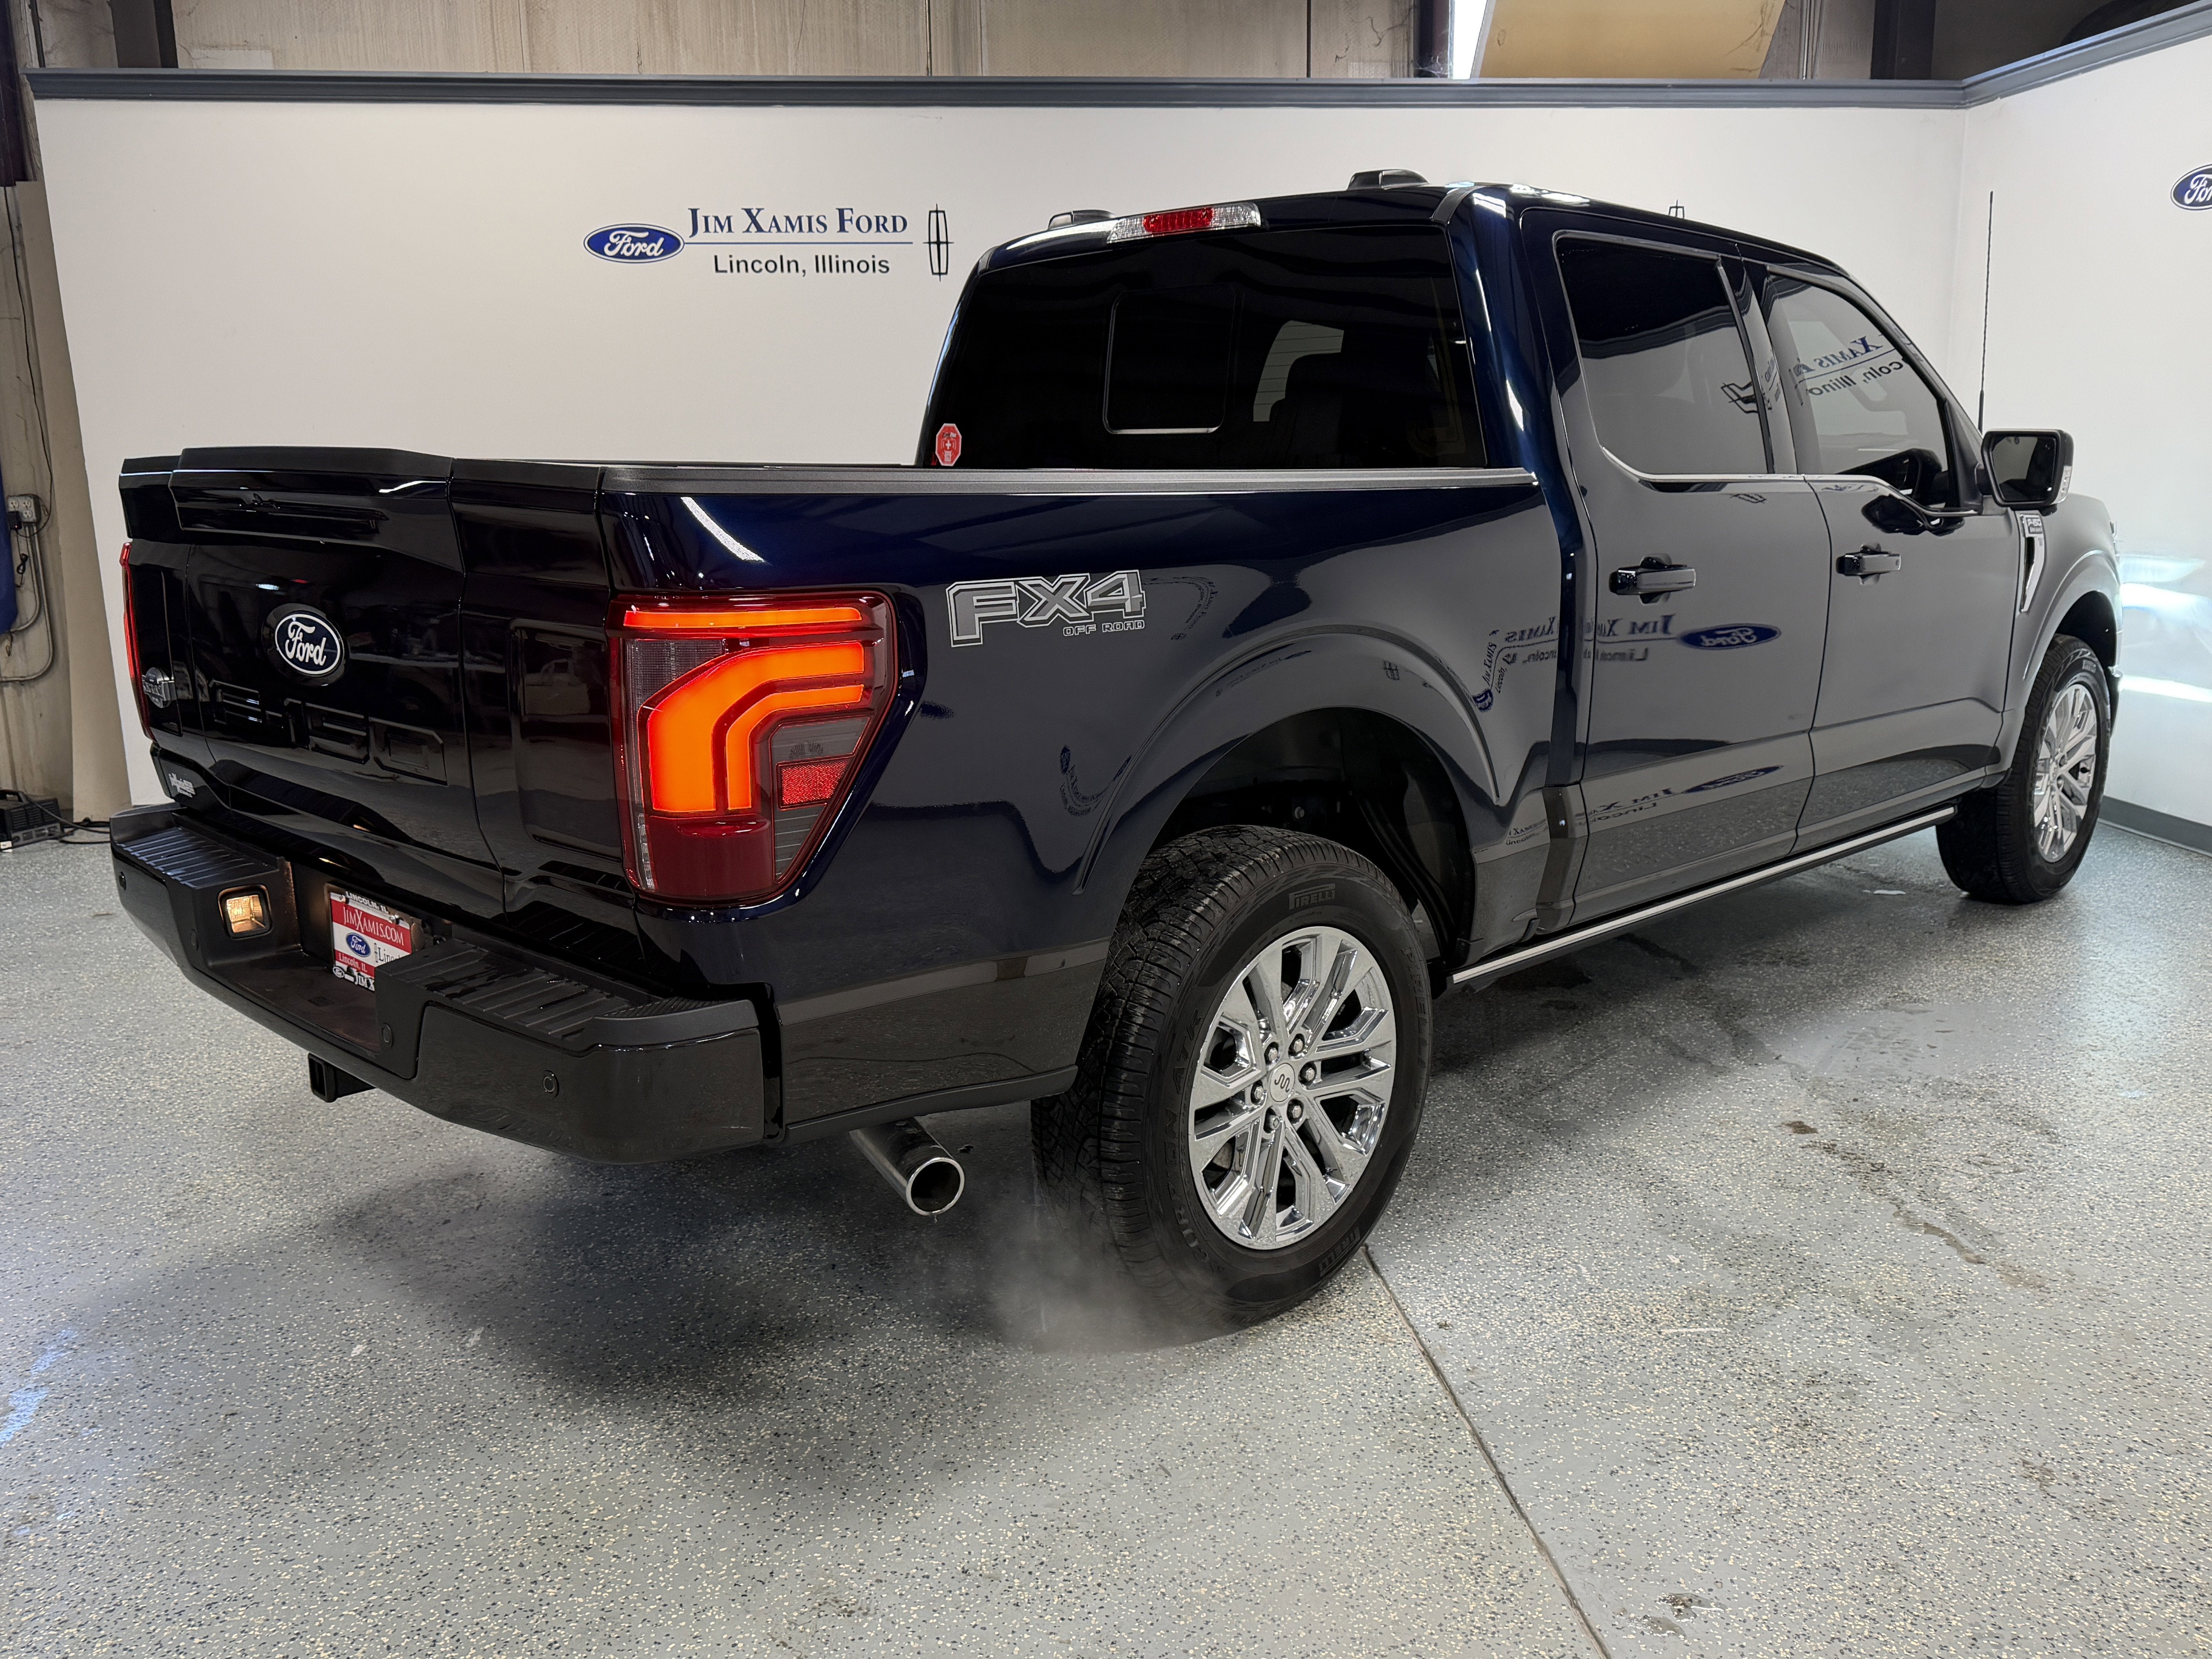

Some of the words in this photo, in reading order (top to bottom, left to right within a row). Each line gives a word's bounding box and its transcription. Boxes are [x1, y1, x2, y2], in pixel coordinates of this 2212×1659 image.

[2184, 174, 2212, 204] For
[688, 208, 733, 239] JIM
[741, 208, 828, 233] XAMIS
[836, 208, 907, 233] FORD
[603, 231, 664, 257] Ford
[714, 255, 807, 277] Lincoln,
[815, 254, 890, 274] Illinois
[946, 570, 1146, 647] FX4
[1063, 624, 1096, 636] OFF
[1102, 620, 1145, 632] ROAD
[285, 621, 326, 666] Ford
[1289, 883, 1335, 909] PIRELLI
[343, 906, 404, 946] JIMXAMIS.COM
[350, 936, 366, 954] Ford
